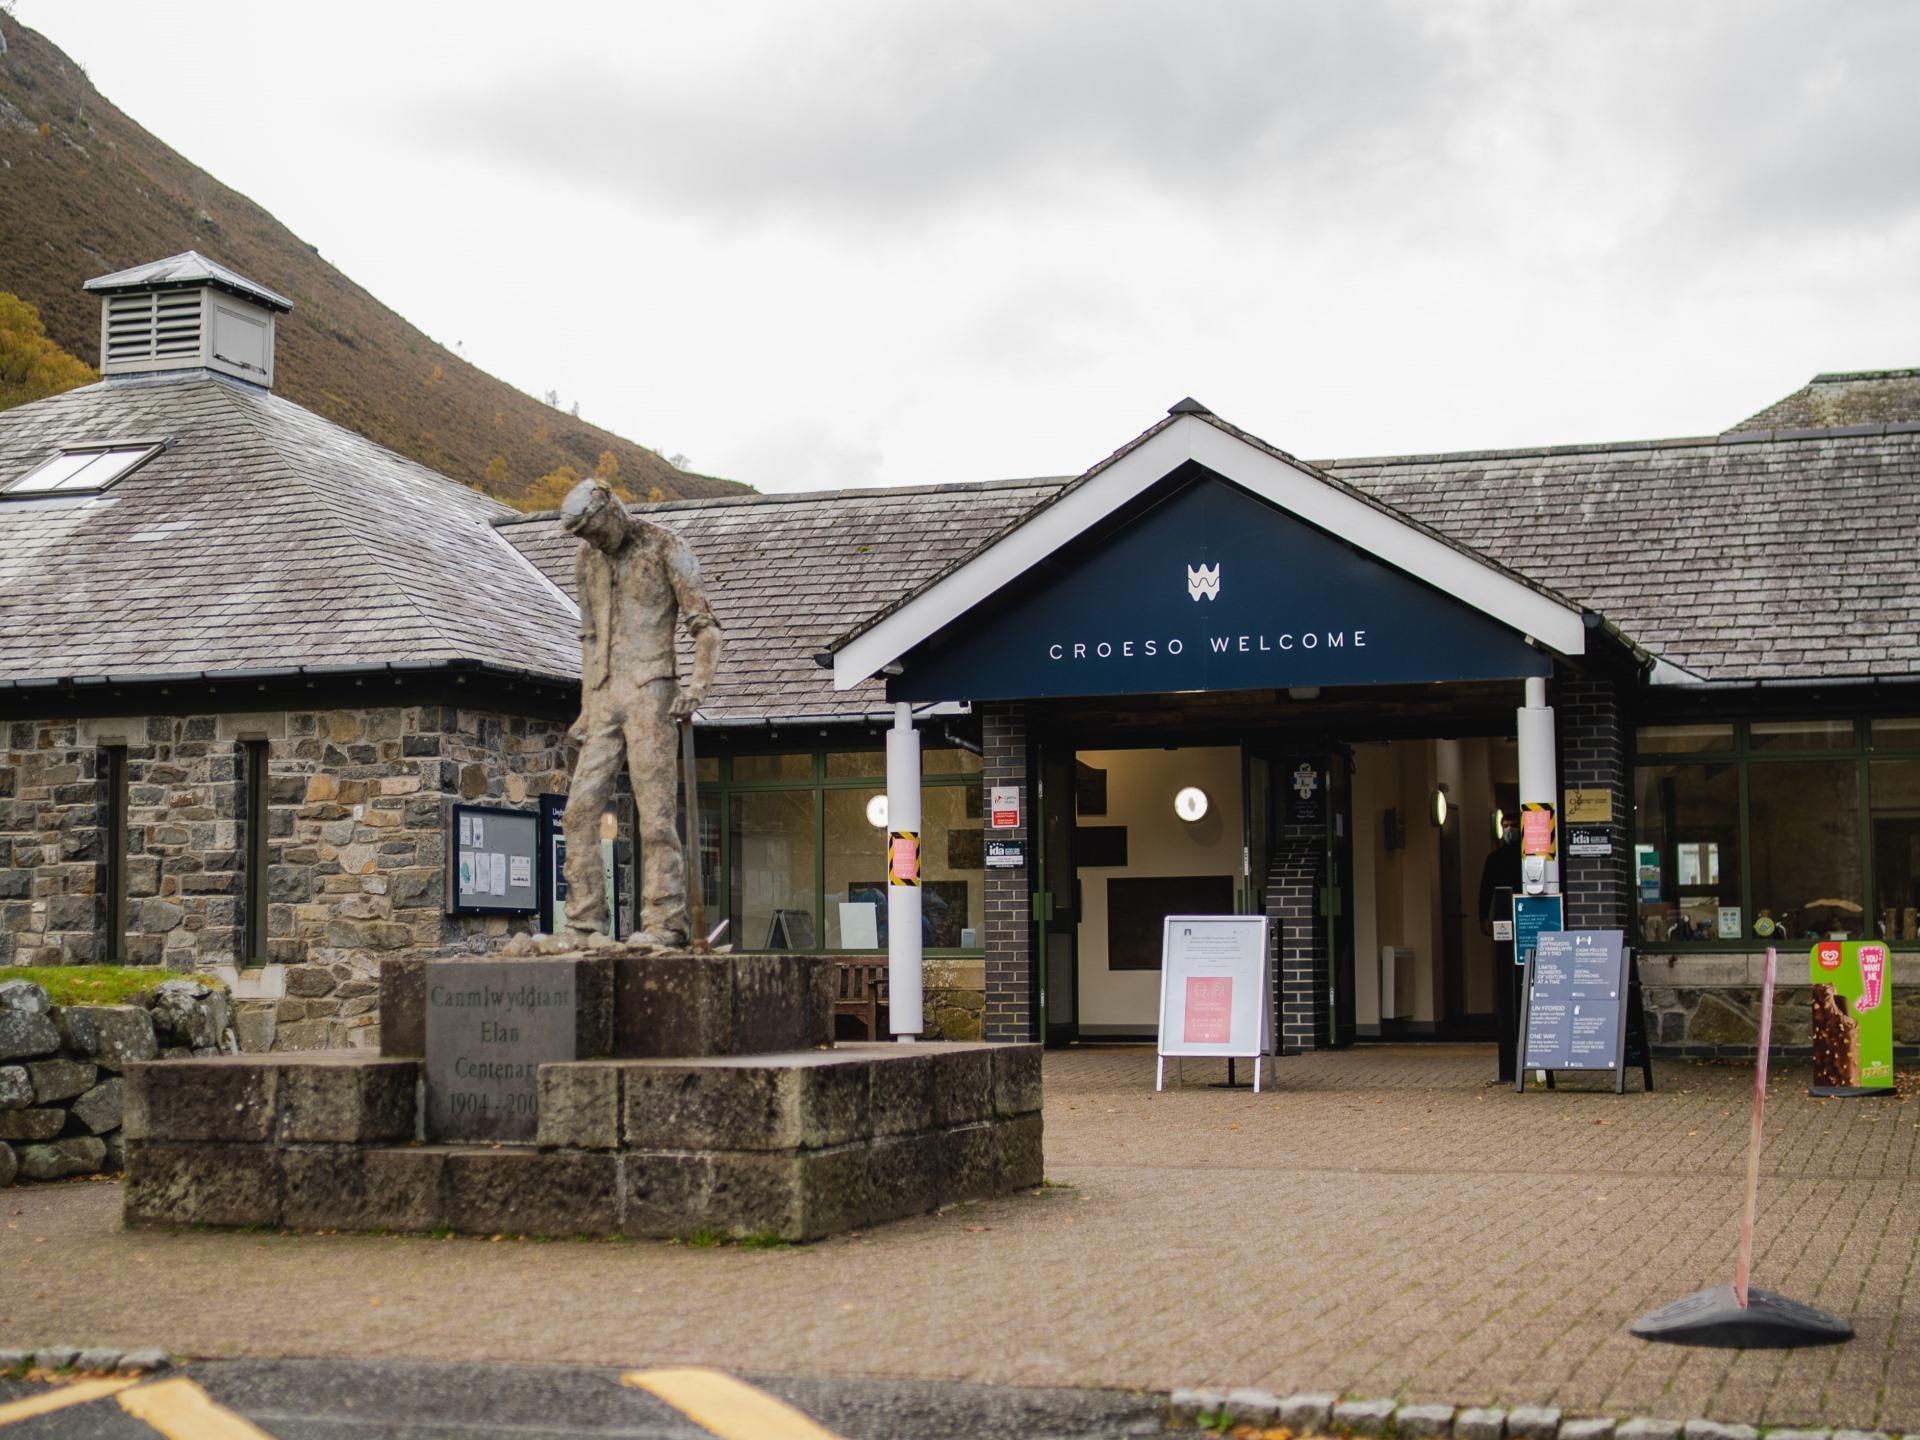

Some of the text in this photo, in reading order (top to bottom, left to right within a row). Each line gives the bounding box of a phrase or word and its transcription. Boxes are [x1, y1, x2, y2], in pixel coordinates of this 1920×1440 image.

[1050, 630, 1366, 659] CROESO WELCOME
[1573, 833, 1590, 844] ida
[989, 845, 1005, 856] ida
[1864, 963, 1881, 971] WANT
[1866, 955, 1879, 963] YOU
[431, 985, 569, 1012] Canmlwyddiant
[481, 1021, 519, 1042] Elan
[455, 1056, 538, 1079] Centenar
[450, 1092, 488, 1115] 1904
[506, 1093, 539, 1115] 200
